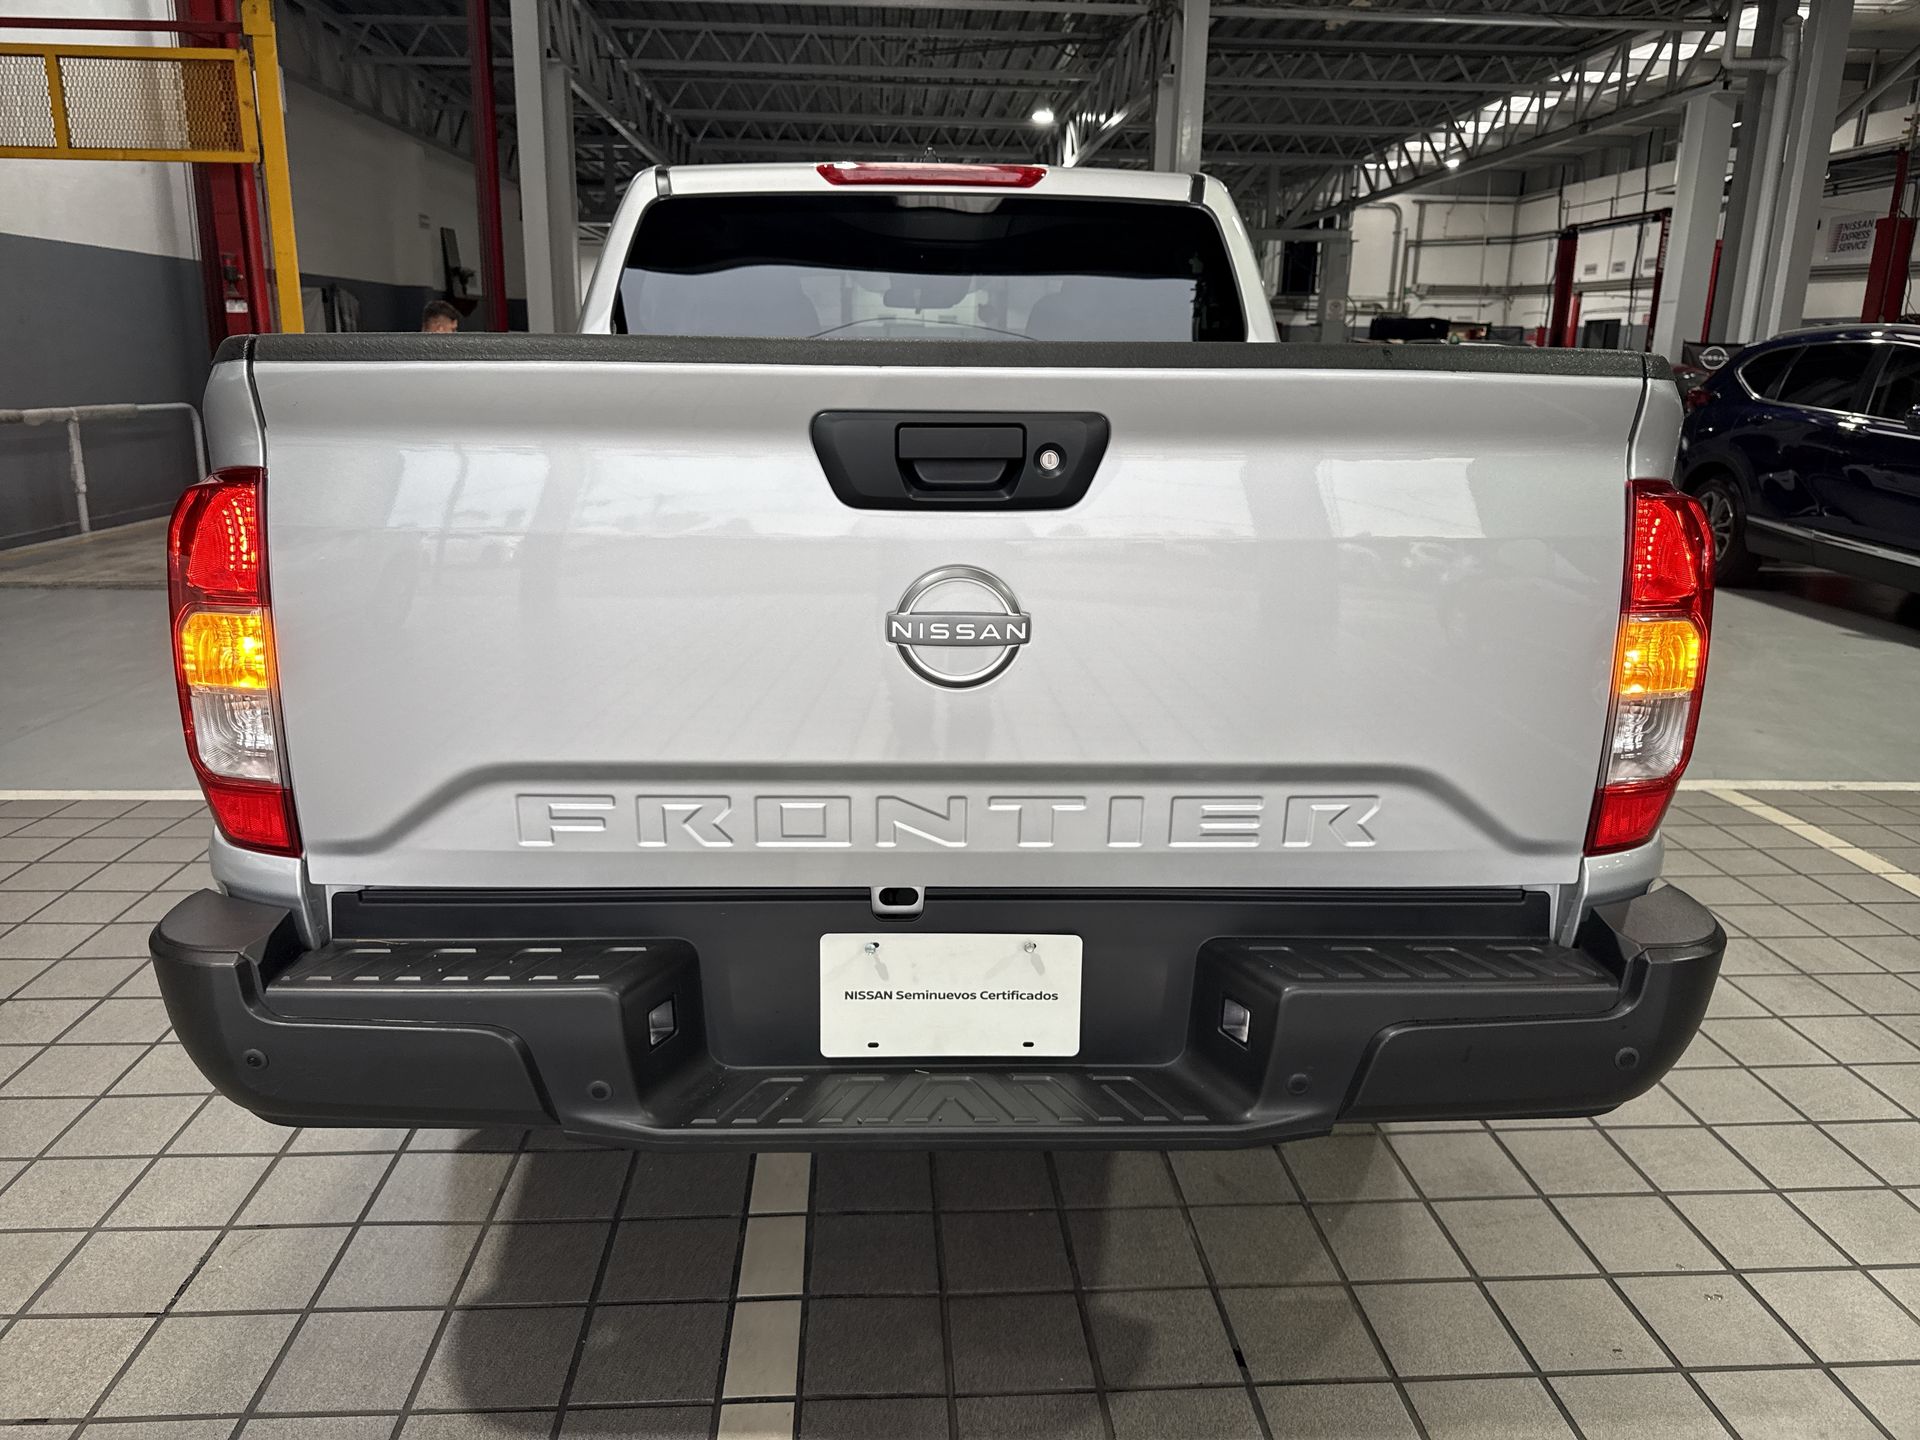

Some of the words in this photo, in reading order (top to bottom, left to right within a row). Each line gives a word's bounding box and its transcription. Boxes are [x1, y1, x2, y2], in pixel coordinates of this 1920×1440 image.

[1842, 219, 1874, 231] NISSAN
[1841, 229, 1871, 241] EXPRESS
[1838, 240, 1868, 252] SERVICE
[891, 621, 1026, 640] NISSAN
[515, 794, 1381, 847] FRONTIER
[844, 990, 893, 1001] NISSAN
[896, 989, 977, 1001] Seminuevos
[980, 990, 1059, 1001] Certificados
